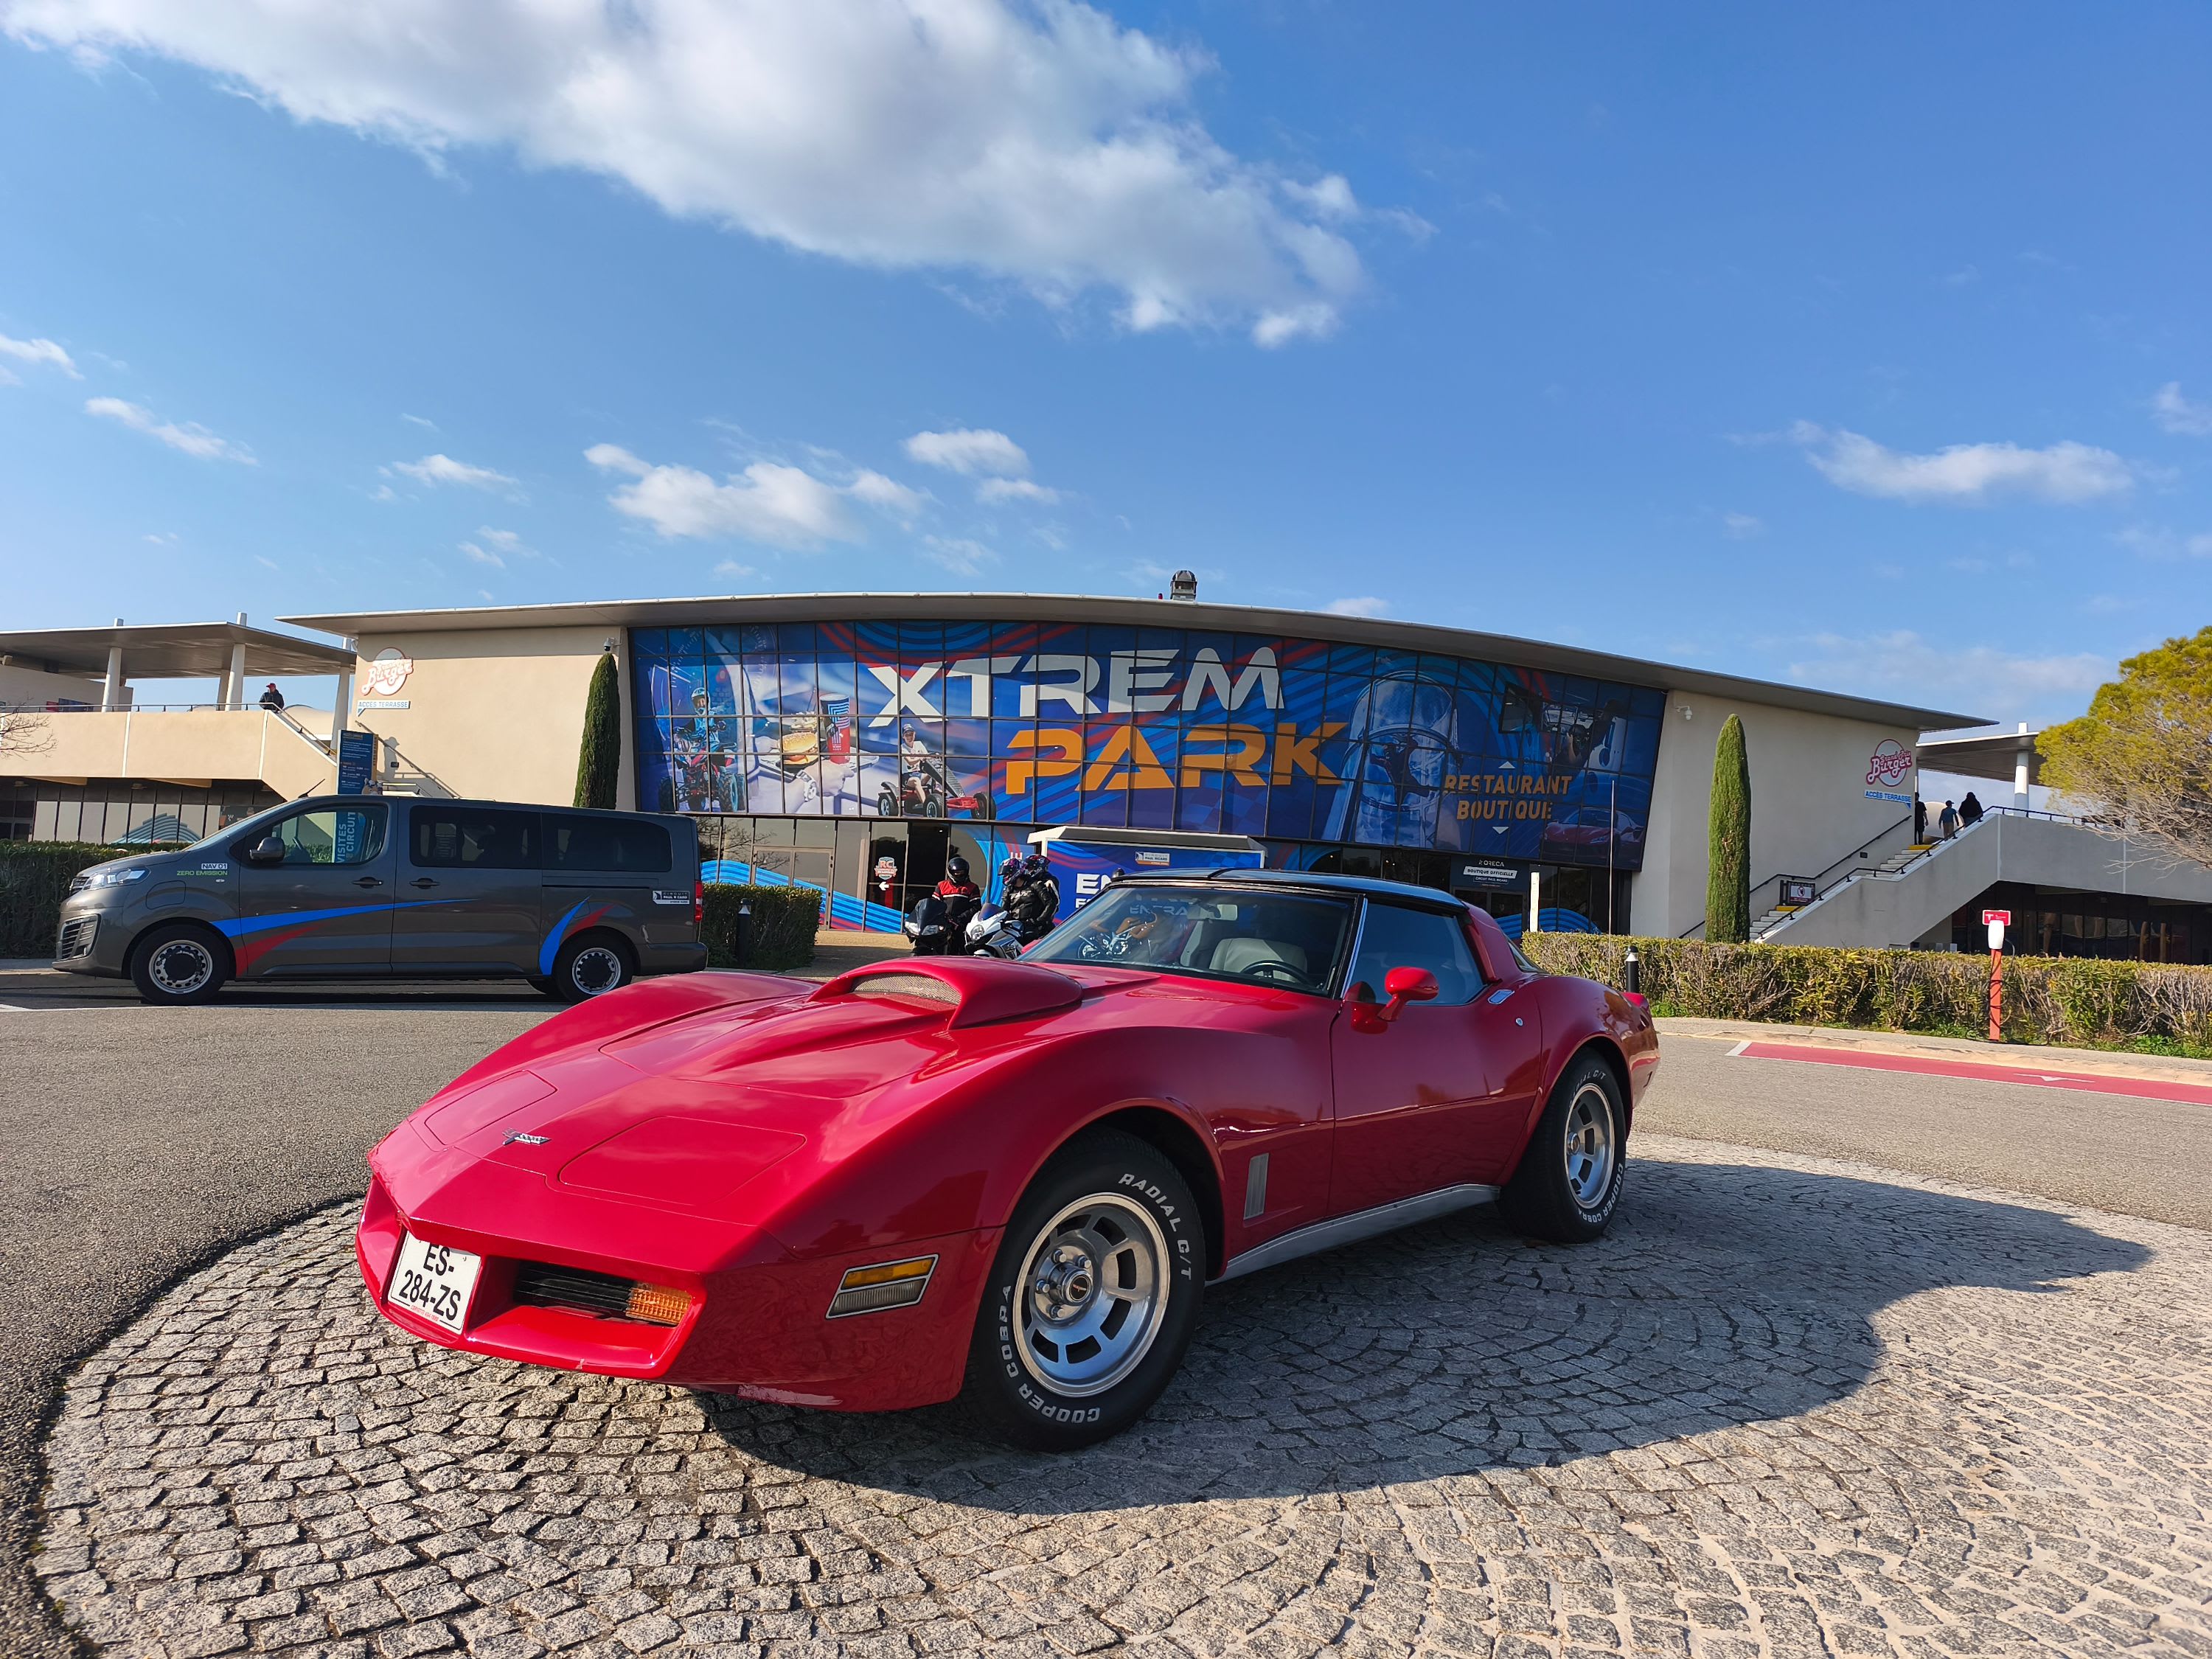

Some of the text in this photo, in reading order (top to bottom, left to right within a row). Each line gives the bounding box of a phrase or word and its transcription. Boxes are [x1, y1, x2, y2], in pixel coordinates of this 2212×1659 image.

[867, 647, 1284, 727] XTREM
[1005, 722, 1348, 795] PARK
[1867, 757, 1911, 782] Burger
[1442, 774, 1572, 796] RESTAURANT
[1884, 793, 1912, 802] TERRASSE
[1456, 799, 1553, 821] BOUTIQUE
[337, 824, 347, 863] VISITES
[1118, 1173, 1183, 1232] RADIAL
[1602, 1163, 1624, 1217] COOPER
[1578, 1208, 1602, 1222] COBRA
[398, 1269, 461, 1321] 284-ZS
[998, 1285, 1019, 1378] COBRA
[1018, 1382, 1101, 1424] COOPER
